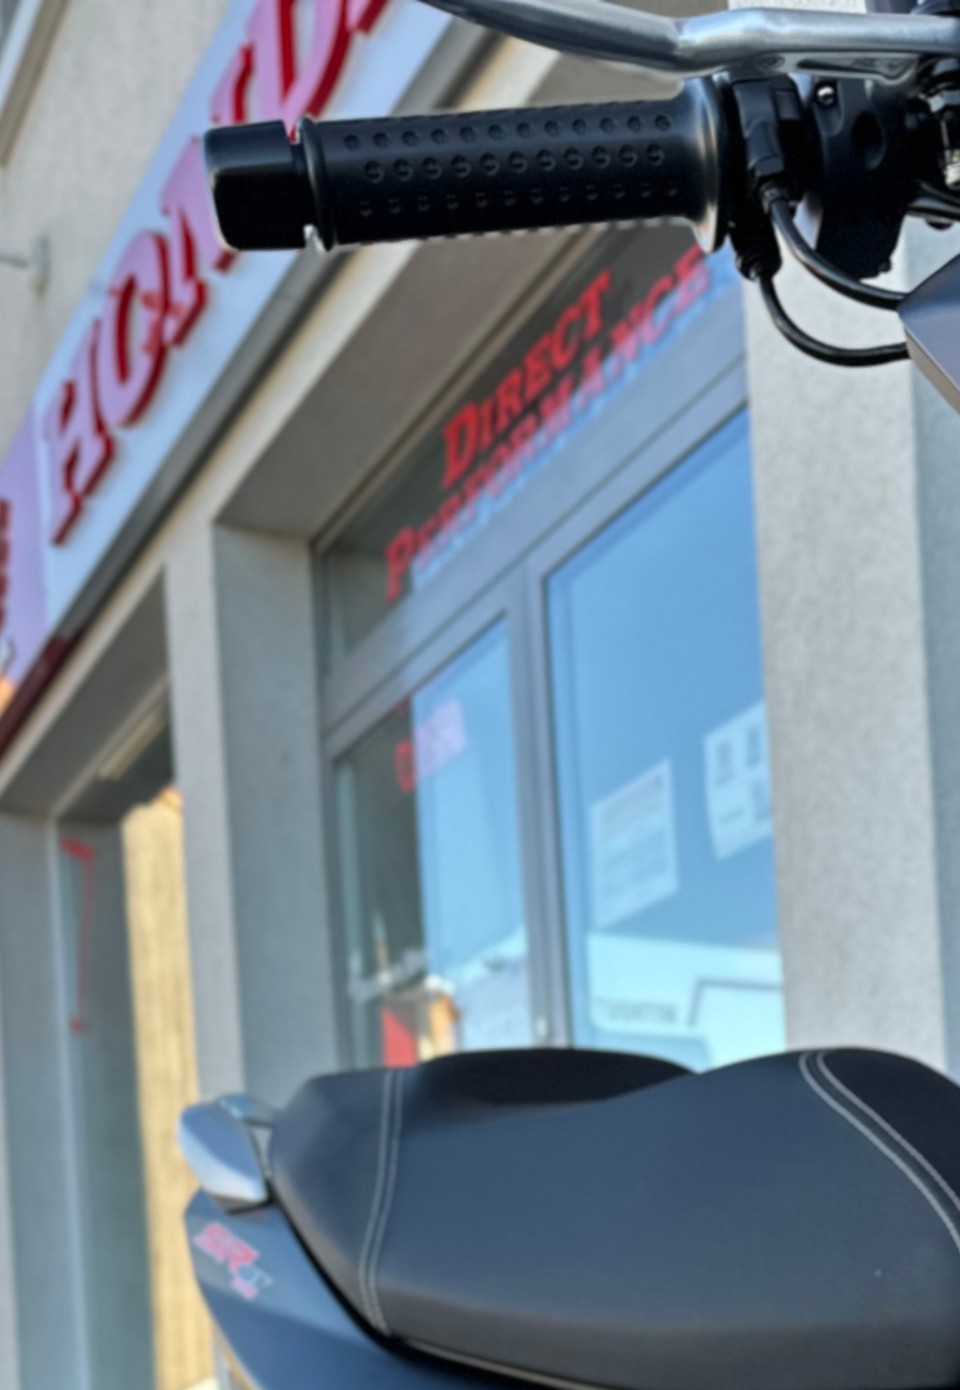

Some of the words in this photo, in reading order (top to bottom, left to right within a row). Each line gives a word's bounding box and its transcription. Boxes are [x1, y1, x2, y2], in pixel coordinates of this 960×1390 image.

[44, 0, 390, 546] HOND
[385, 243, 711, 603] PERFORMANCE
[443, 268, 611, 489] DIRECT
